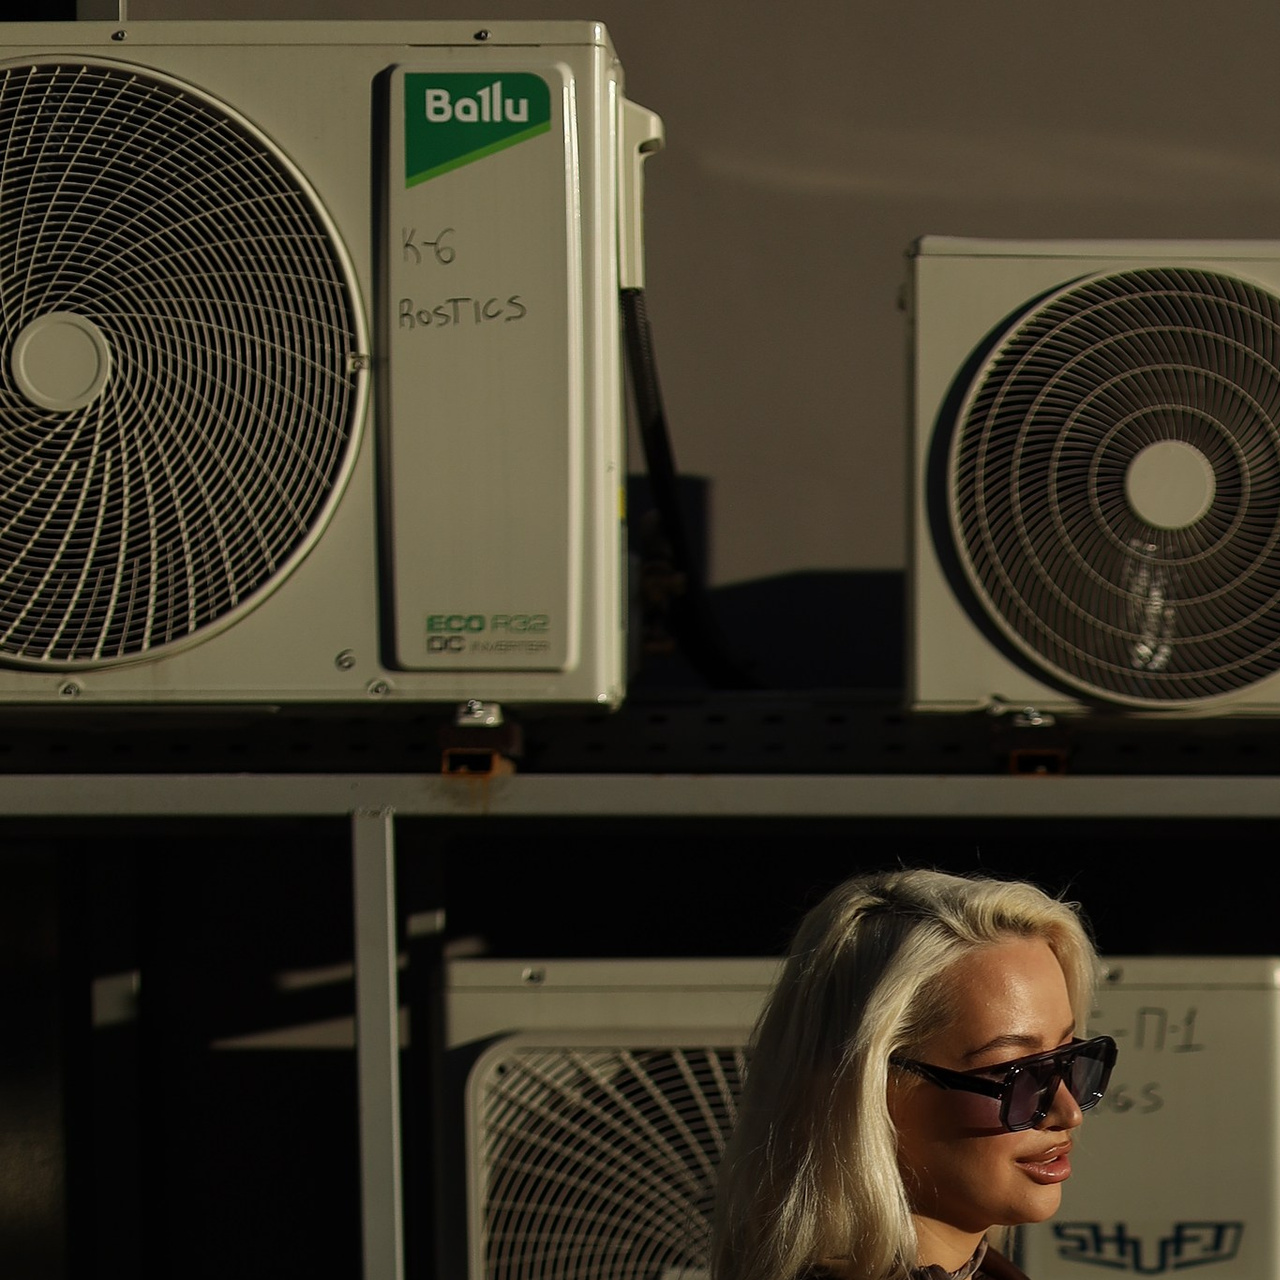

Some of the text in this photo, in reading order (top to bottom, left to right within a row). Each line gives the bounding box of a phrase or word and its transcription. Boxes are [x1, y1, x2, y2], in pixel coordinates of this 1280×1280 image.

[424, 80, 530, 124] Ballu
[427, 614, 550, 633] ECO R32
[427, 635, 465, 654] DC
[1053, 1221, 1244, 1276] SHUFT
